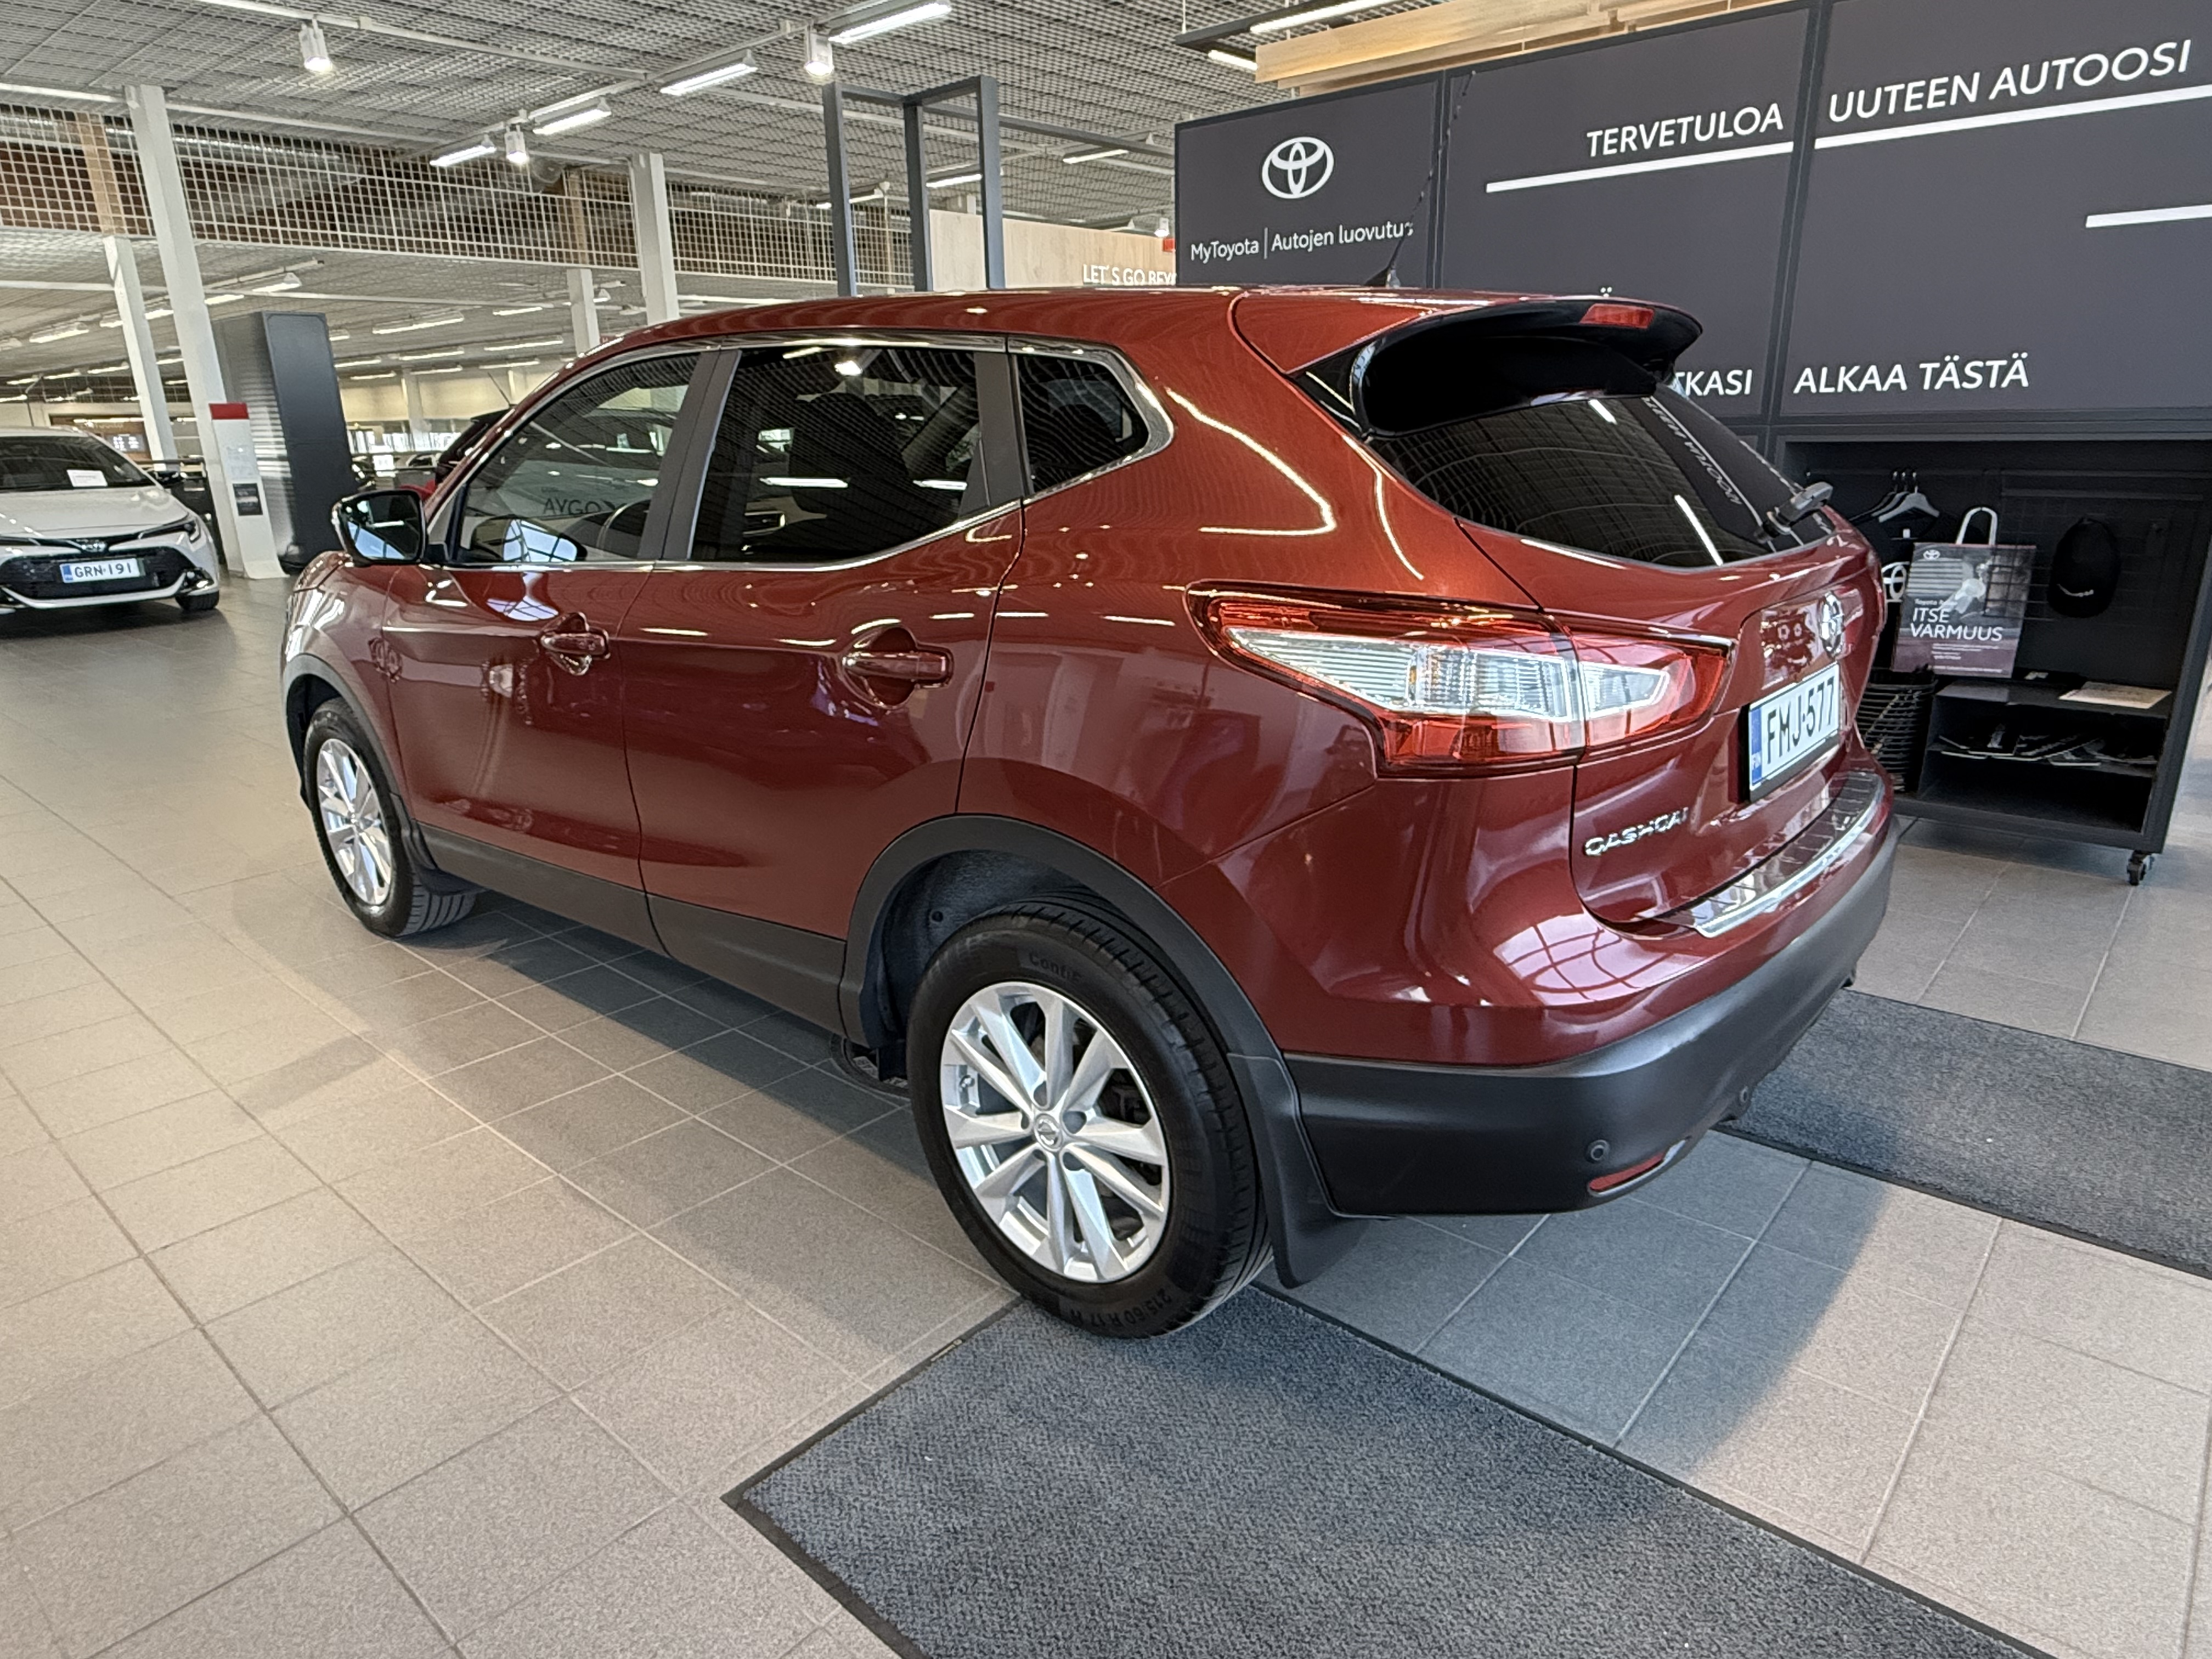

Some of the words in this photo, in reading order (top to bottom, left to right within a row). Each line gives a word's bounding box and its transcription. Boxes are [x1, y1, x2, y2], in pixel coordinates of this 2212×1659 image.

[1829, 72, 1980, 122] UUTEEN
[1989, 39, 2191, 100] AUTOOSI
[1587, 103, 1784, 157] TERVETULOA
[1190, 238, 1259, 264] MyToyota
[1271, 227, 1334, 252] Autojen
[1123, 268, 1146, 286] GO
[1793, 364, 1908, 394] ALKAA
[1919, 352, 2029, 390] TÄSTÄ
[75, 562, 132, 578] GRN-191
[1910, 623, 2003, 641] VARMUUS
[1912, 607, 1950, 623] ITSE
[1768, 676, 1835, 764] FMJ-577
